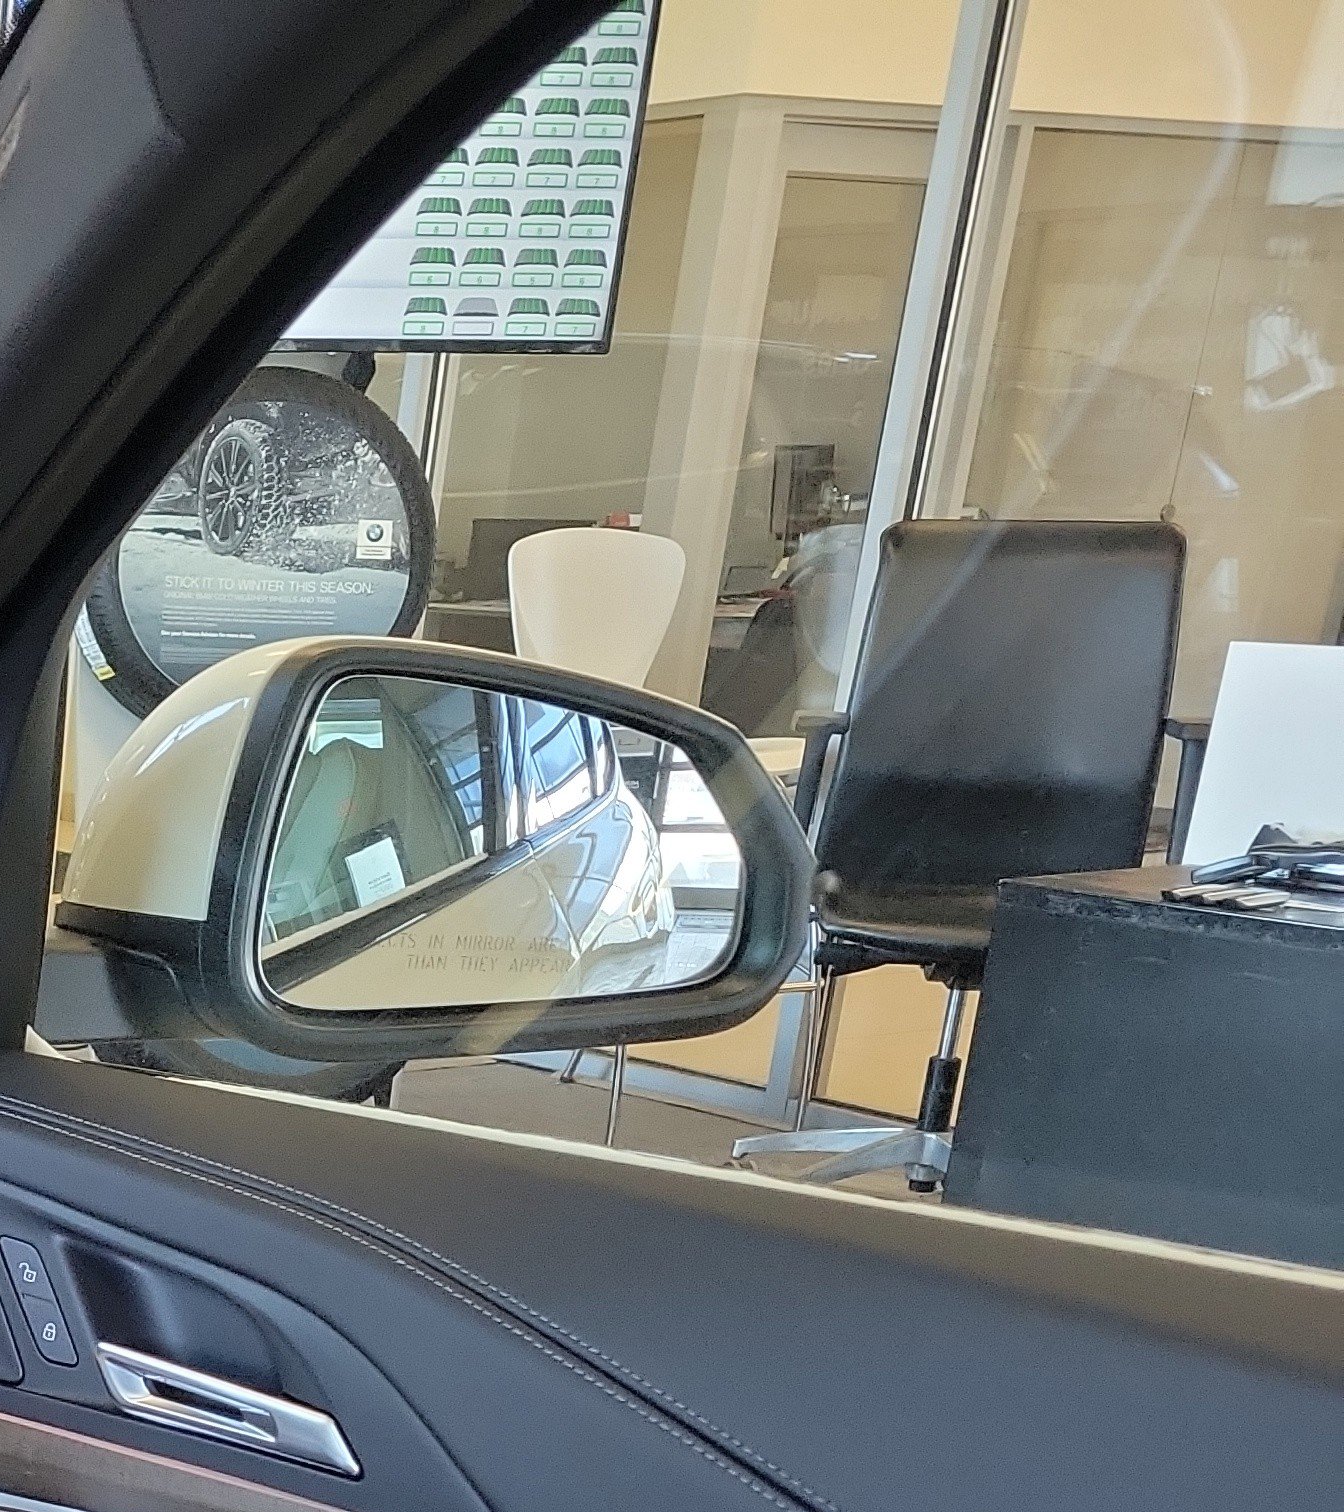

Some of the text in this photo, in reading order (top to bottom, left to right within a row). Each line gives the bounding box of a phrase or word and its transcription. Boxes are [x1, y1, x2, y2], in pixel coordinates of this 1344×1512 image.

[165, 575, 374, 595] STICK IT TO WINTER THIS SEASON.
[428, 933, 445, 949] IN
[455, 933, 516, 951] MIRROR
[527, 936, 560, 952] ARE
[406, 953, 448, 971] THAN
[460, 955, 499, 973] THEY
